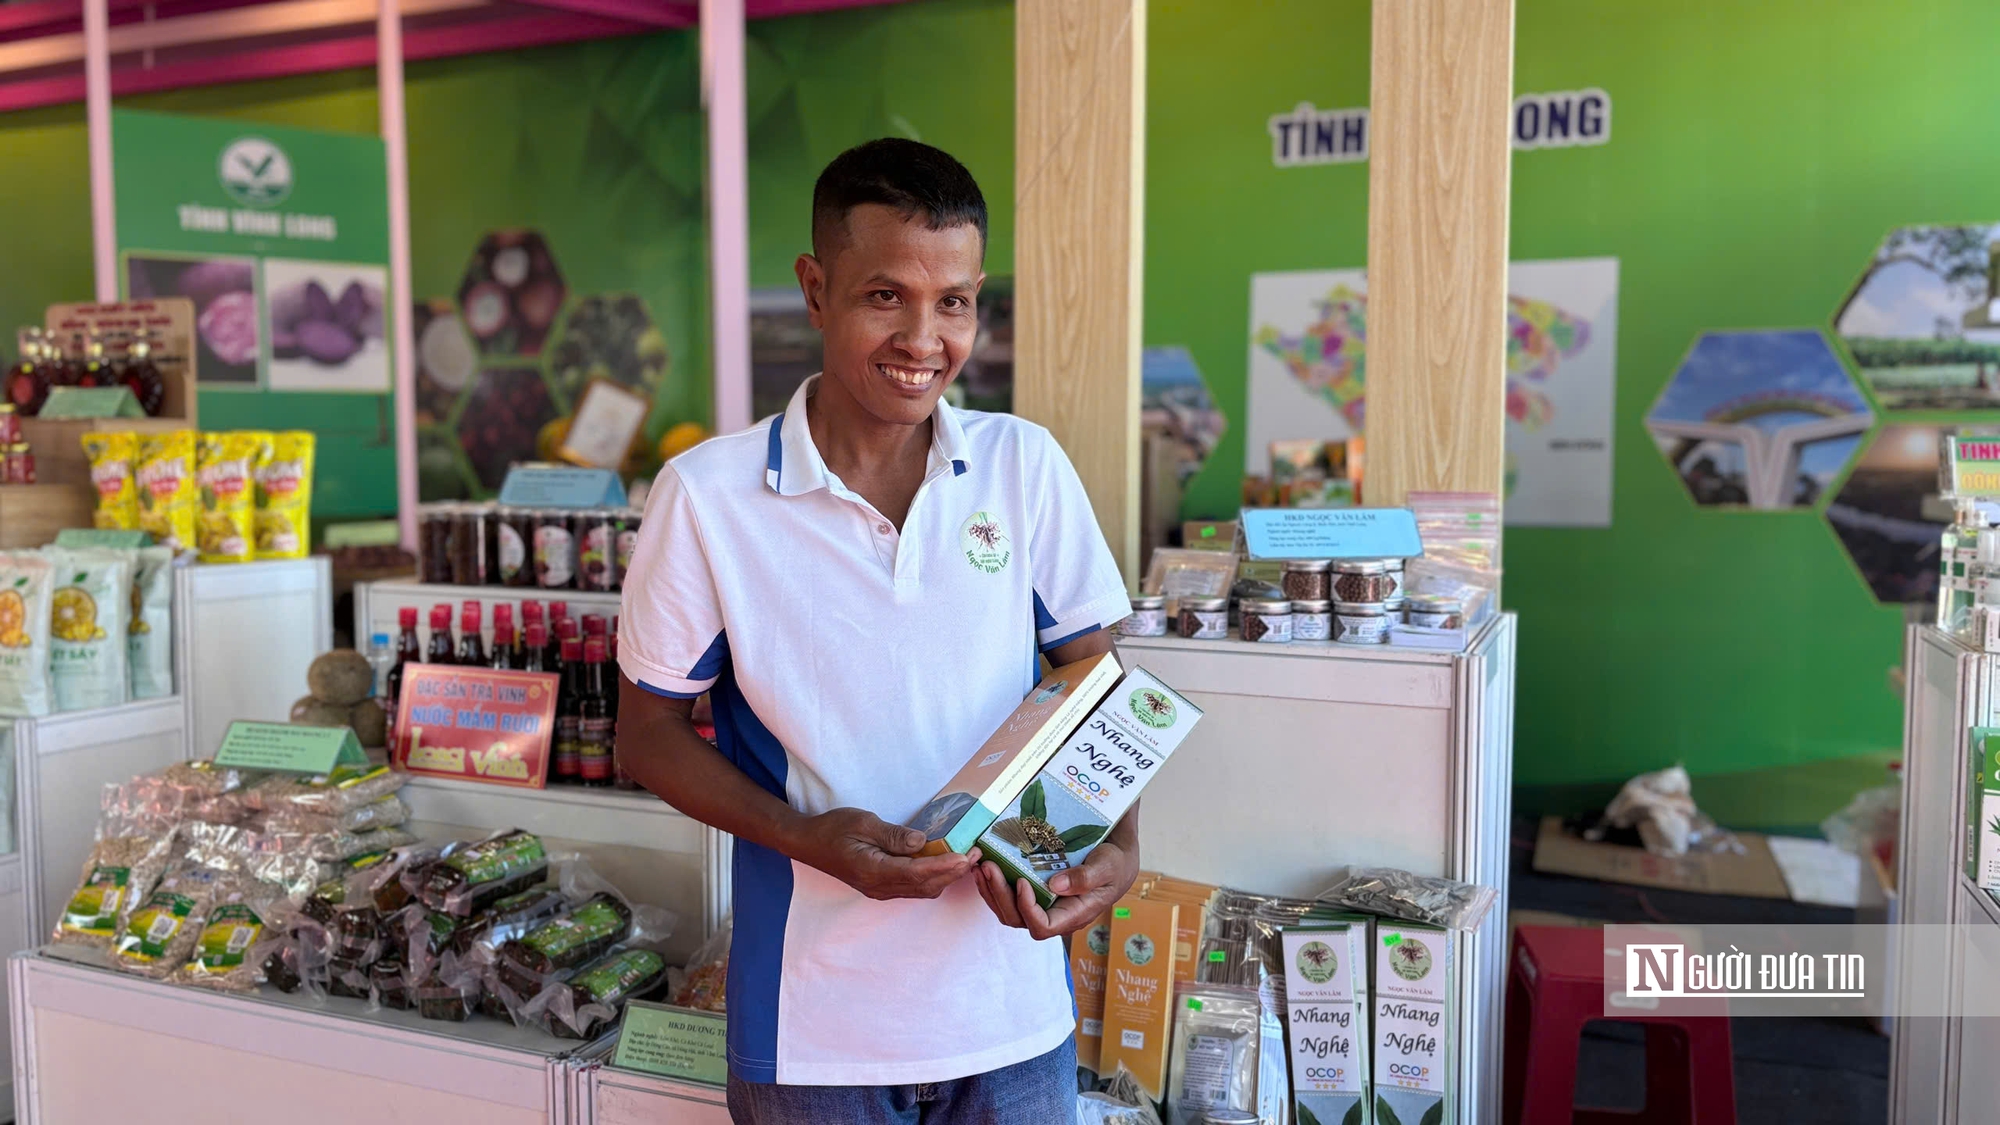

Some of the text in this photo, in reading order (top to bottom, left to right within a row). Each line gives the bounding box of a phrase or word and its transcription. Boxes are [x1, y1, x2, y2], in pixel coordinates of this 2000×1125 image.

[1089, 720, 1155, 770] Nhang
[1075, 742, 1136, 789] Nghệ
[1066, 765, 1110, 797] OCOP
[1078, 957, 1107, 977] Nhan
[1080, 973, 1105, 994] Ngh
[1115, 968, 1158, 993] Nhang
[1117, 984, 1153, 1007] Nghệ
[1293, 1007, 1350, 1028] Nhang
[1380, 1003, 1440, 1027] Nhang
[668, 1021, 686, 1029] HKD
[687, 1024, 715, 1035] DƯƠNG
[1299, 1035, 1350, 1059] Nghệ
[1383, 1032, 1436, 1057] Nghệ
[1306, 1067, 1344, 1078] OCOP
[1389, 1063, 1429, 1077] OCOP
